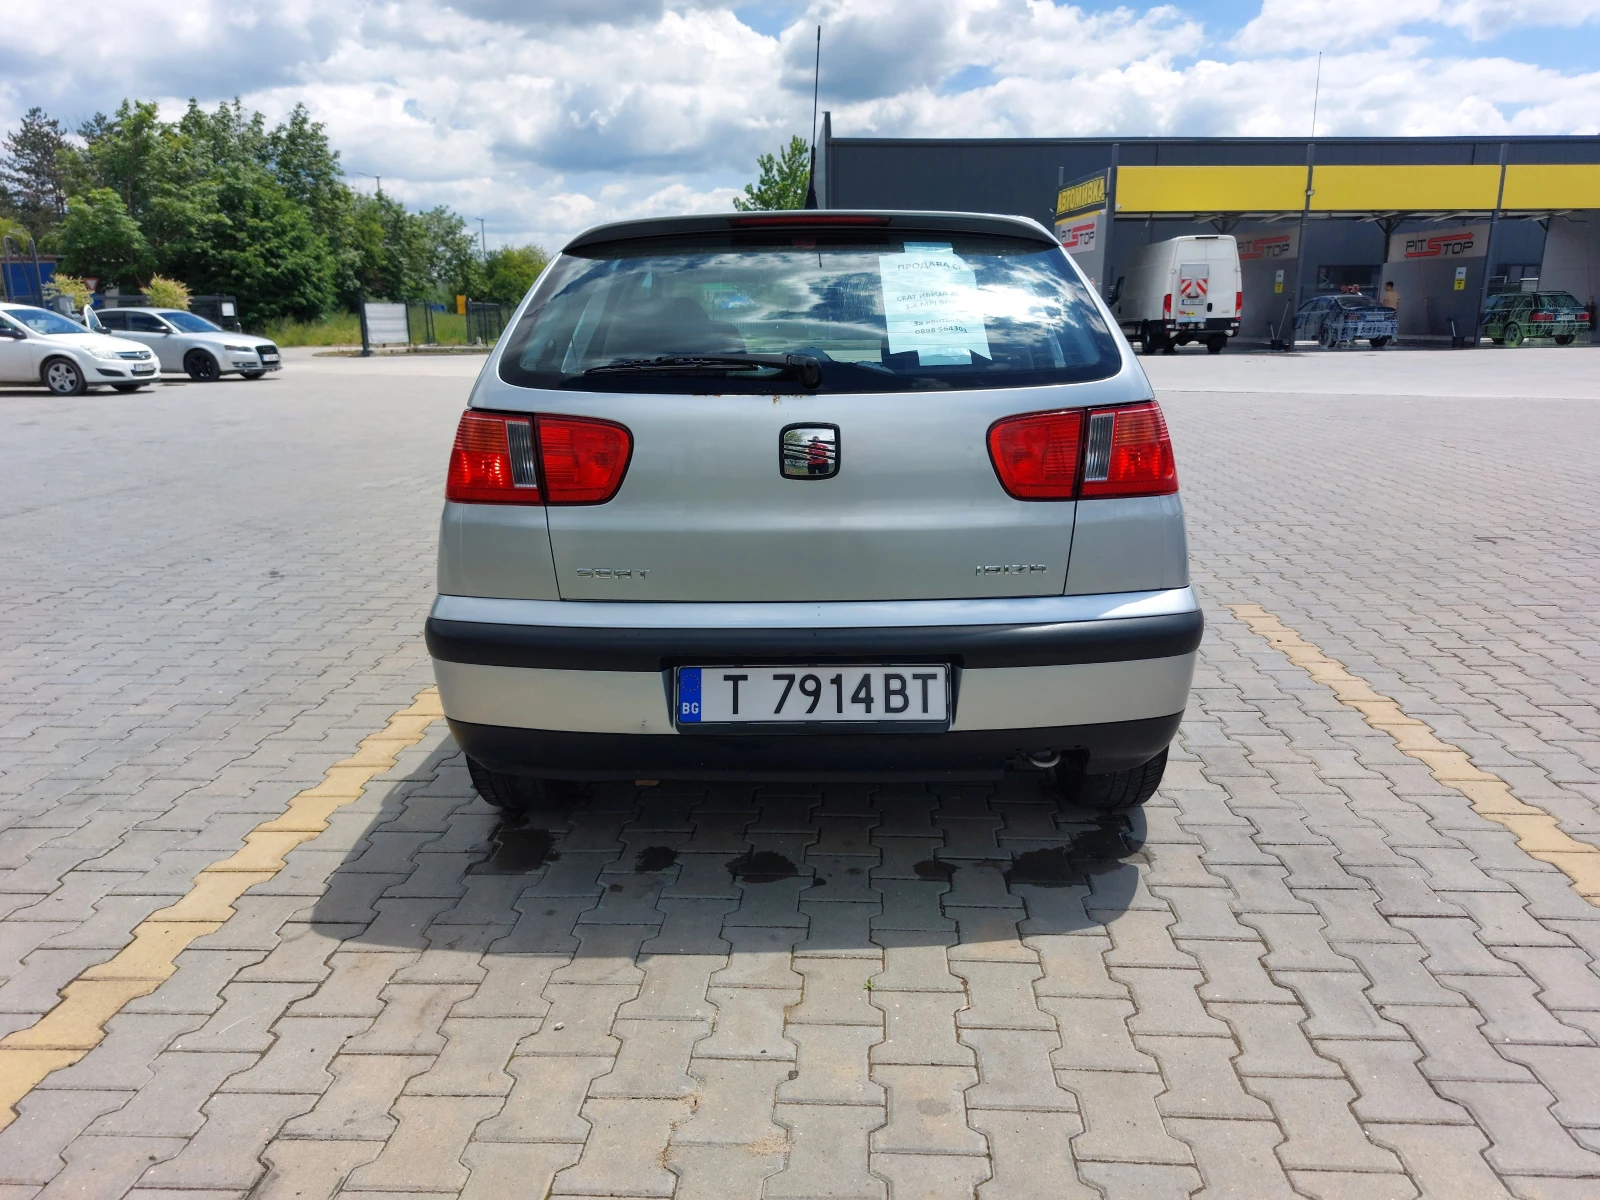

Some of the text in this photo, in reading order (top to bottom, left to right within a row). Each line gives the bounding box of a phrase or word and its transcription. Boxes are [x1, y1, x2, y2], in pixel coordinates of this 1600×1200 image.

[1057, 177, 1105, 213] АВТОМИВКА
[1061, 229, 1072, 241] PIT
[1406, 233, 1474, 256] PIT STOP
[897, 261, 950, 271] ПРОДАВА
[576, 567, 651, 579] SEAT
[976, 564, 1047, 576] IBIZA
[723, 674, 748, 715] T
[682, 702, 699, 715] BG
